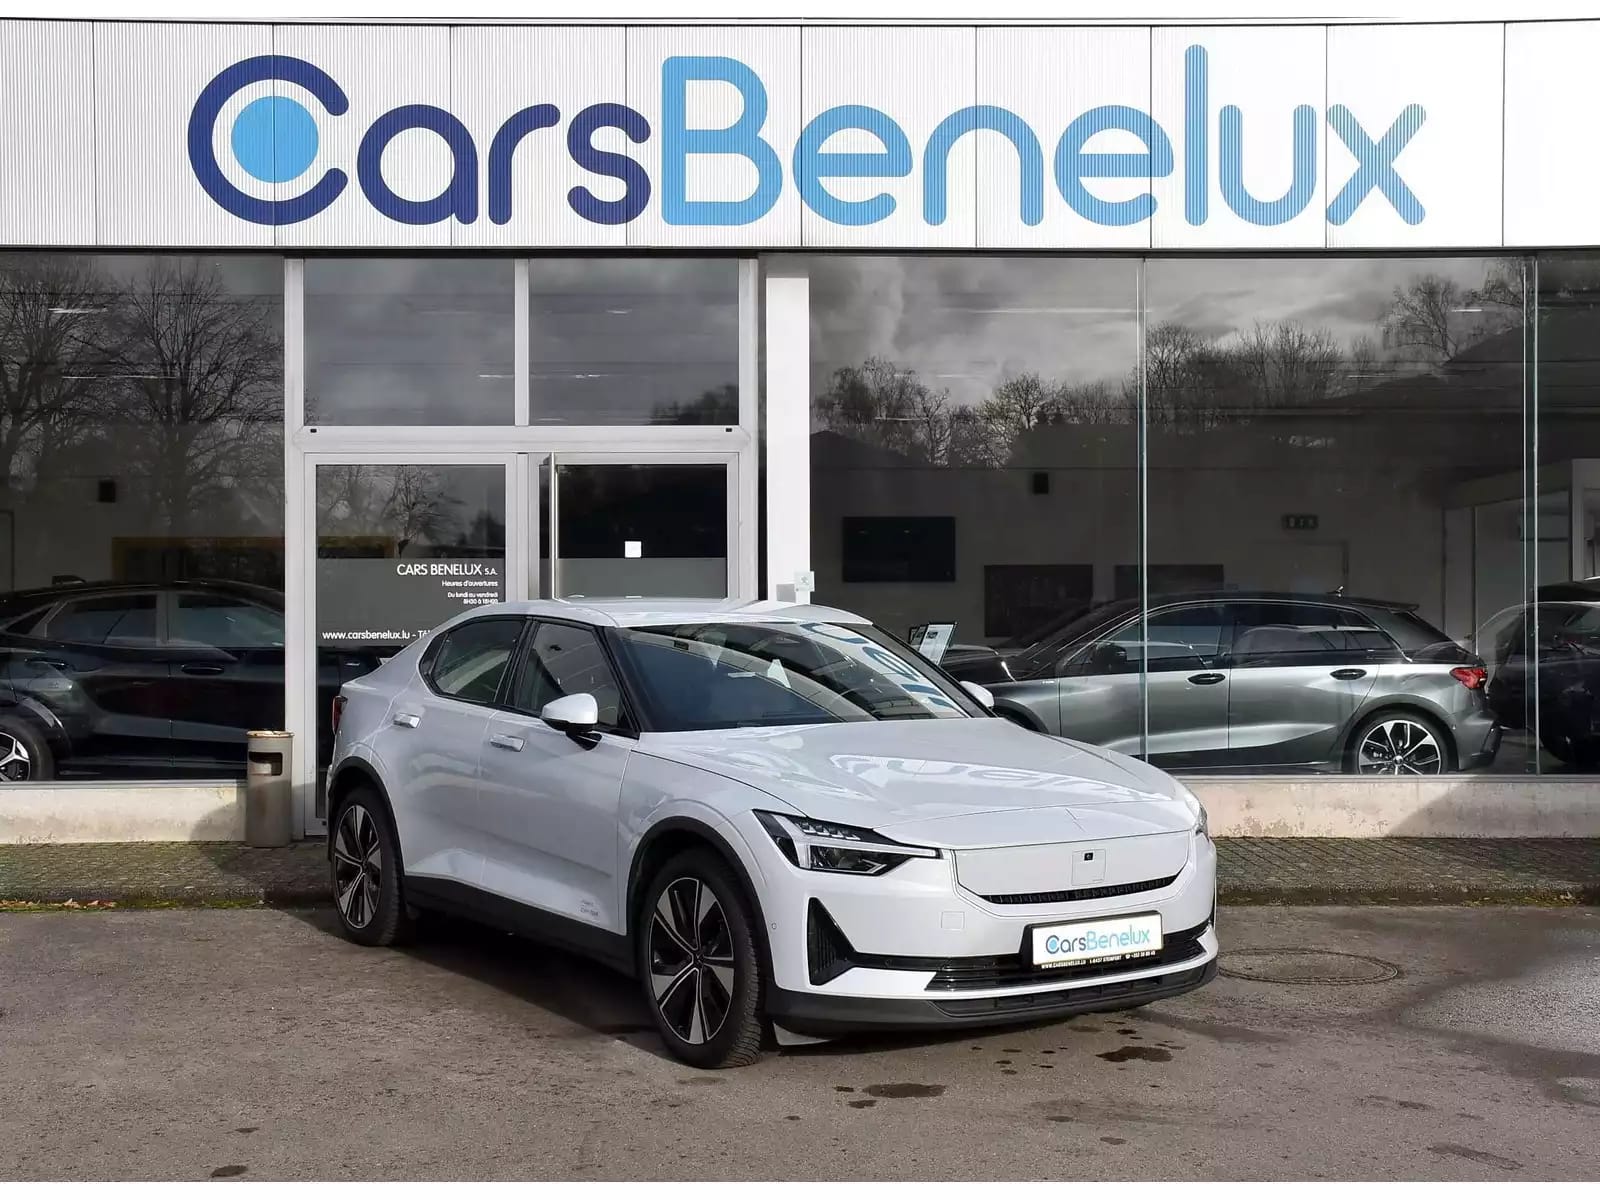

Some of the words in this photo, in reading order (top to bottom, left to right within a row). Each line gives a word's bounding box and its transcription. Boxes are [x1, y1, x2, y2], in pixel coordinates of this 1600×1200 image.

[188, 45, 1427, 226] CarsBenelux
[397, 564, 428, 575] CARS
[430, 564, 482, 575] BENELUX
[322, 630, 410, 639] www.carsbenelux.lu
[1045, 925, 1150, 954] CarsBenelux
